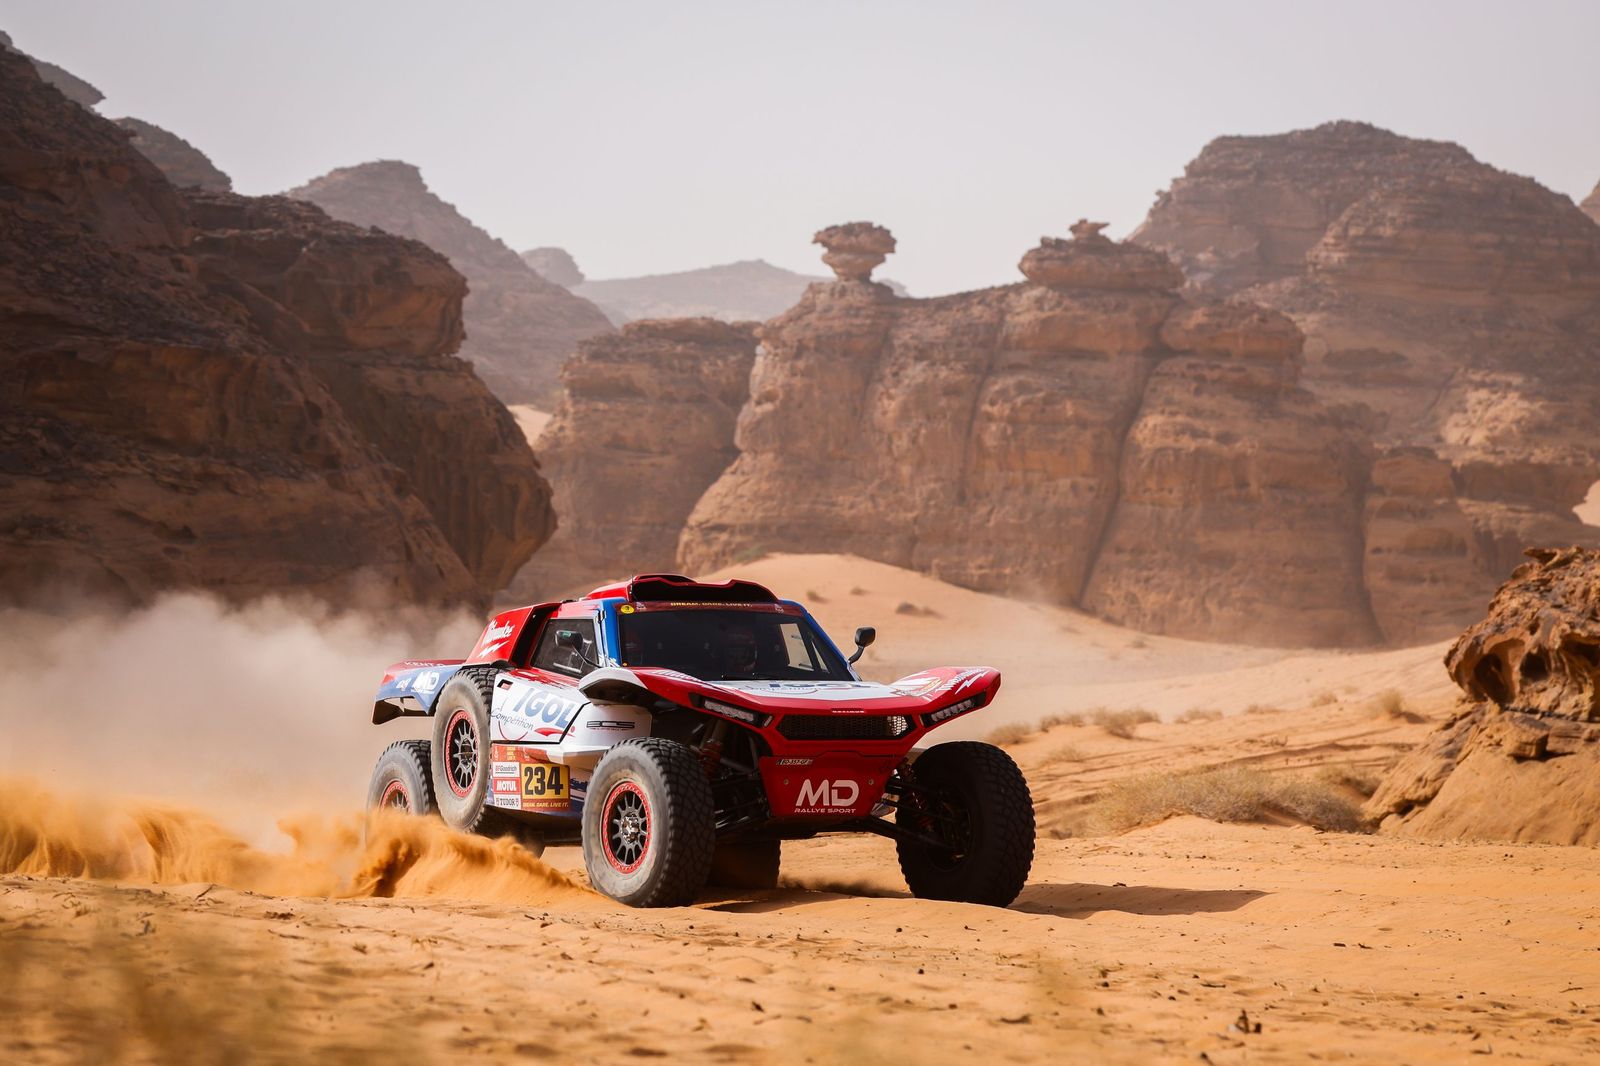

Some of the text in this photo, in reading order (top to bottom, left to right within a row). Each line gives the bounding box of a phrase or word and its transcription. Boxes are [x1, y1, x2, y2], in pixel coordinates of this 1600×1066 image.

[513, 687, 575, 729] IGOL
[496, 780, 517, 792] MOTUL
[524, 766, 564, 795] 234
[795, 779, 860, 807] MD
[499, 798, 517, 807] TUDOR
